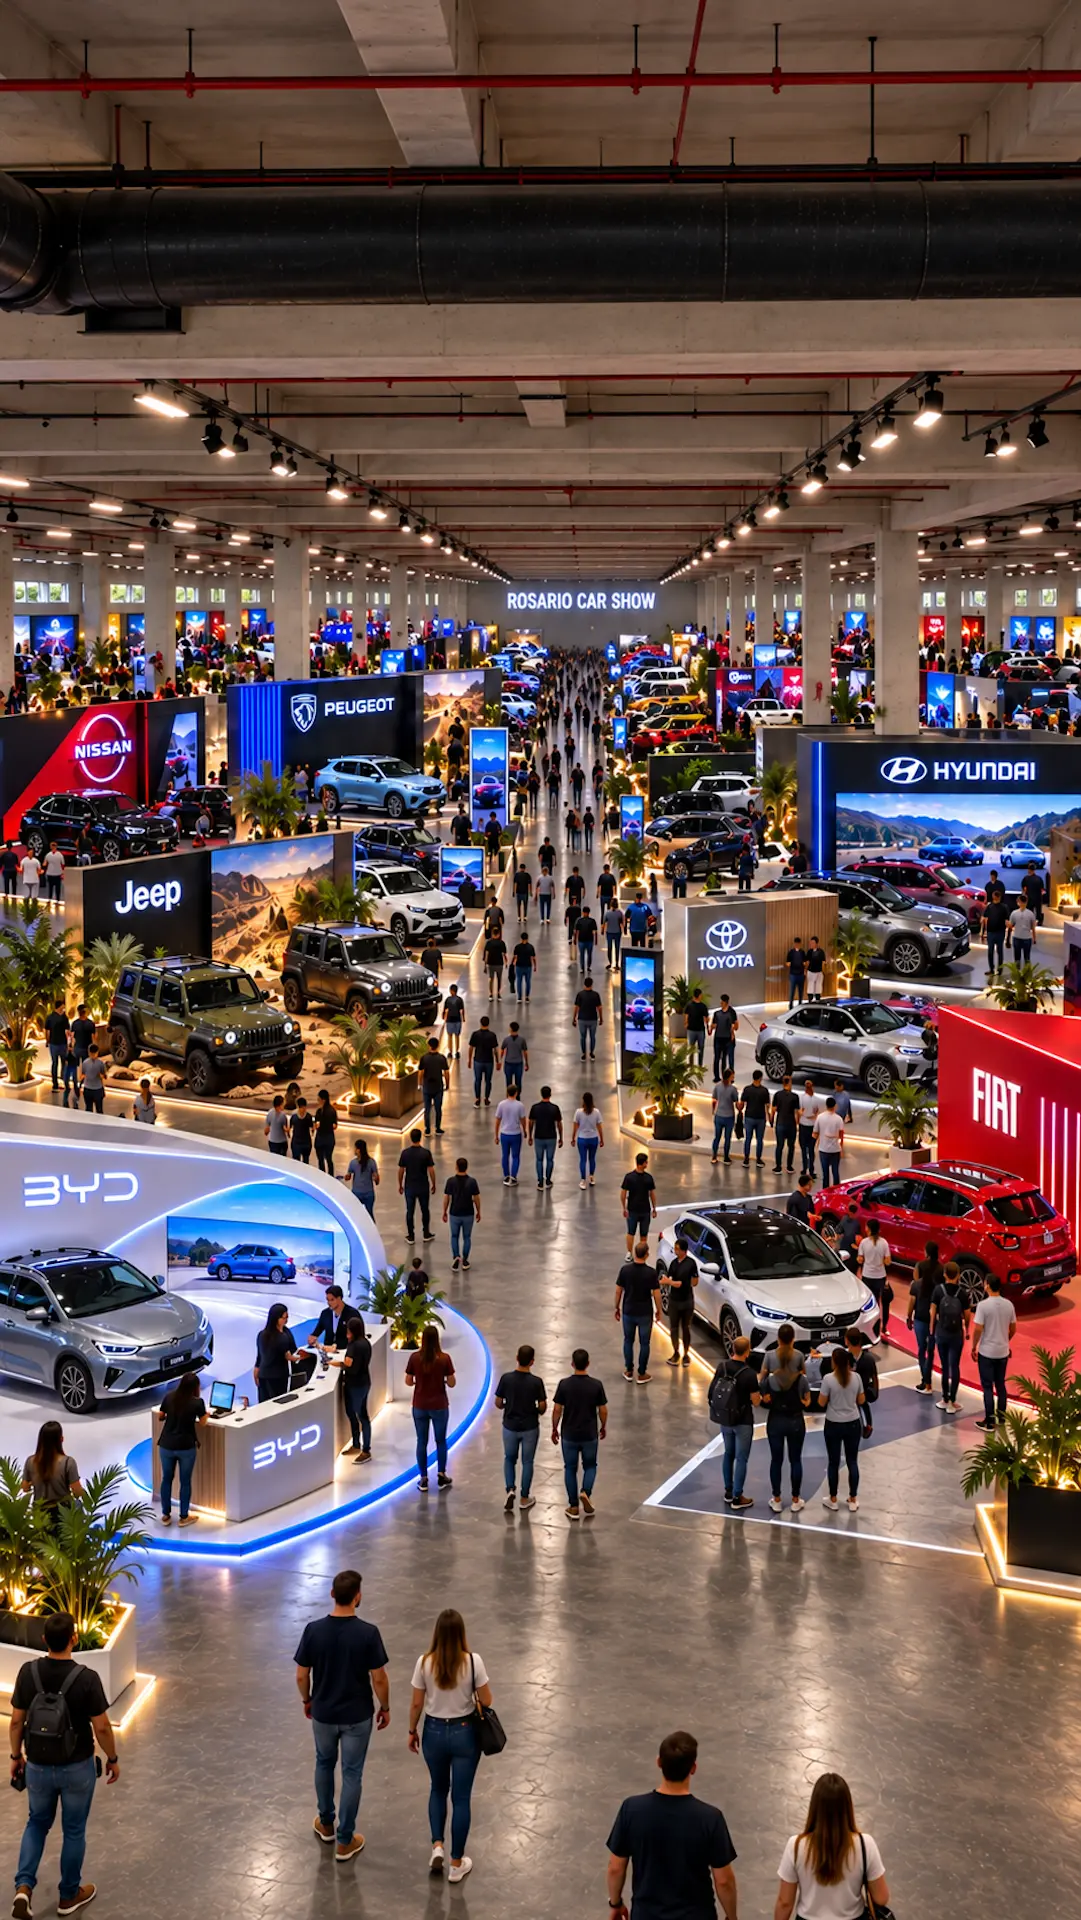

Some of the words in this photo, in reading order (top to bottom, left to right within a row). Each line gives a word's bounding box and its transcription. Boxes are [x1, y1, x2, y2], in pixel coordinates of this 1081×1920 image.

[507, 592, 572, 609] ROSARIO
[577, 592, 607, 609] CAR
[611, 592, 655, 609] SHOW
[324, 697, 395, 717] PEUGEOT
[74, 738, 132, 760] NISSAN
[933, 761, 1036, 781] HYUNDAI
[114, 879, 182, 914] Jeep
[697, 953, 755, 971] TOYOTA
[972, 1066, 1021, 1139] FIAT
[23, 1171, 139, 1208] BYD
[253, 1423, 322, 1471] BYD
